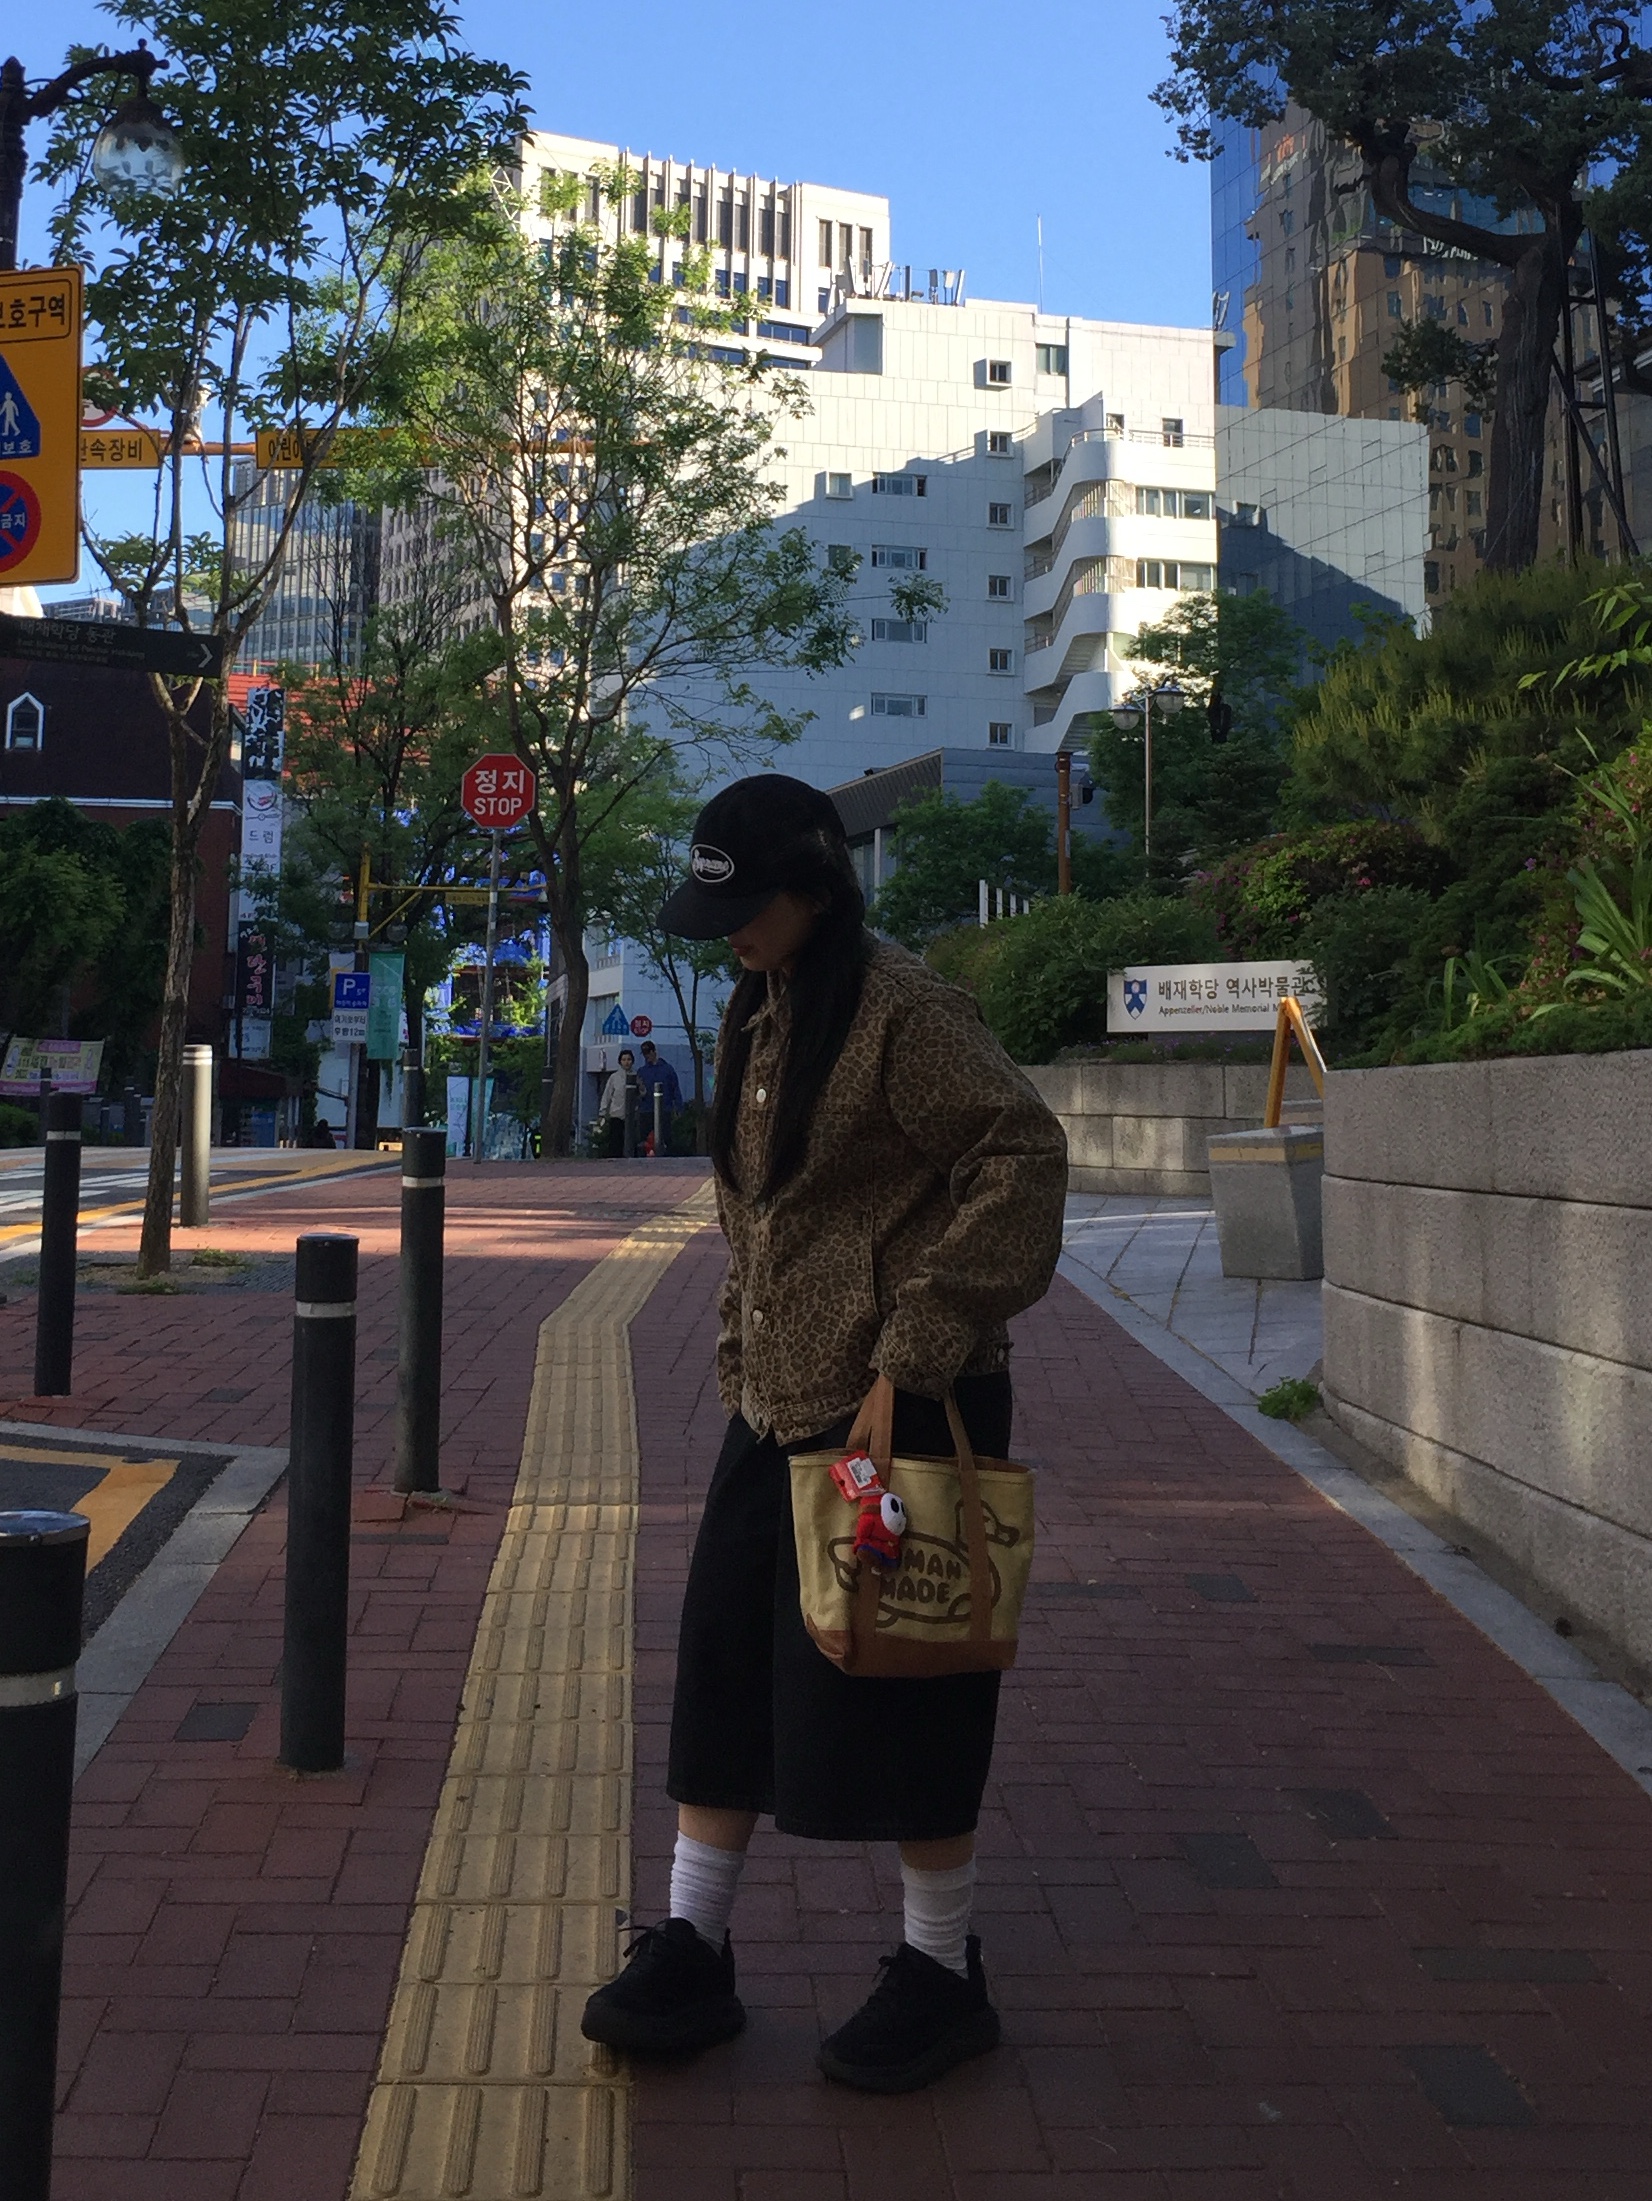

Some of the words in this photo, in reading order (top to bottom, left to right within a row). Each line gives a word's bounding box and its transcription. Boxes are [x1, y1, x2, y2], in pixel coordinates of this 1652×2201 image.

[0, 293, 65, 328] 호구역
[1, 513, 26, 528] 금지
[86, 626, 116, 645] 동관
[475, 769, 525, 794] 정지
[474, 797, 522, 816] STOP
[342, 978, 356, 996] P
[1158, 979, 1219, 1000] 배재학당
[1226, 976, 1306, 998] 역사박물관
[1158, 1004, 1230, 1018] Appenzeller/Noble
[1232, 1003, 1269, 1013] Memorial
[879, 1576, 950, 1604] MADE
